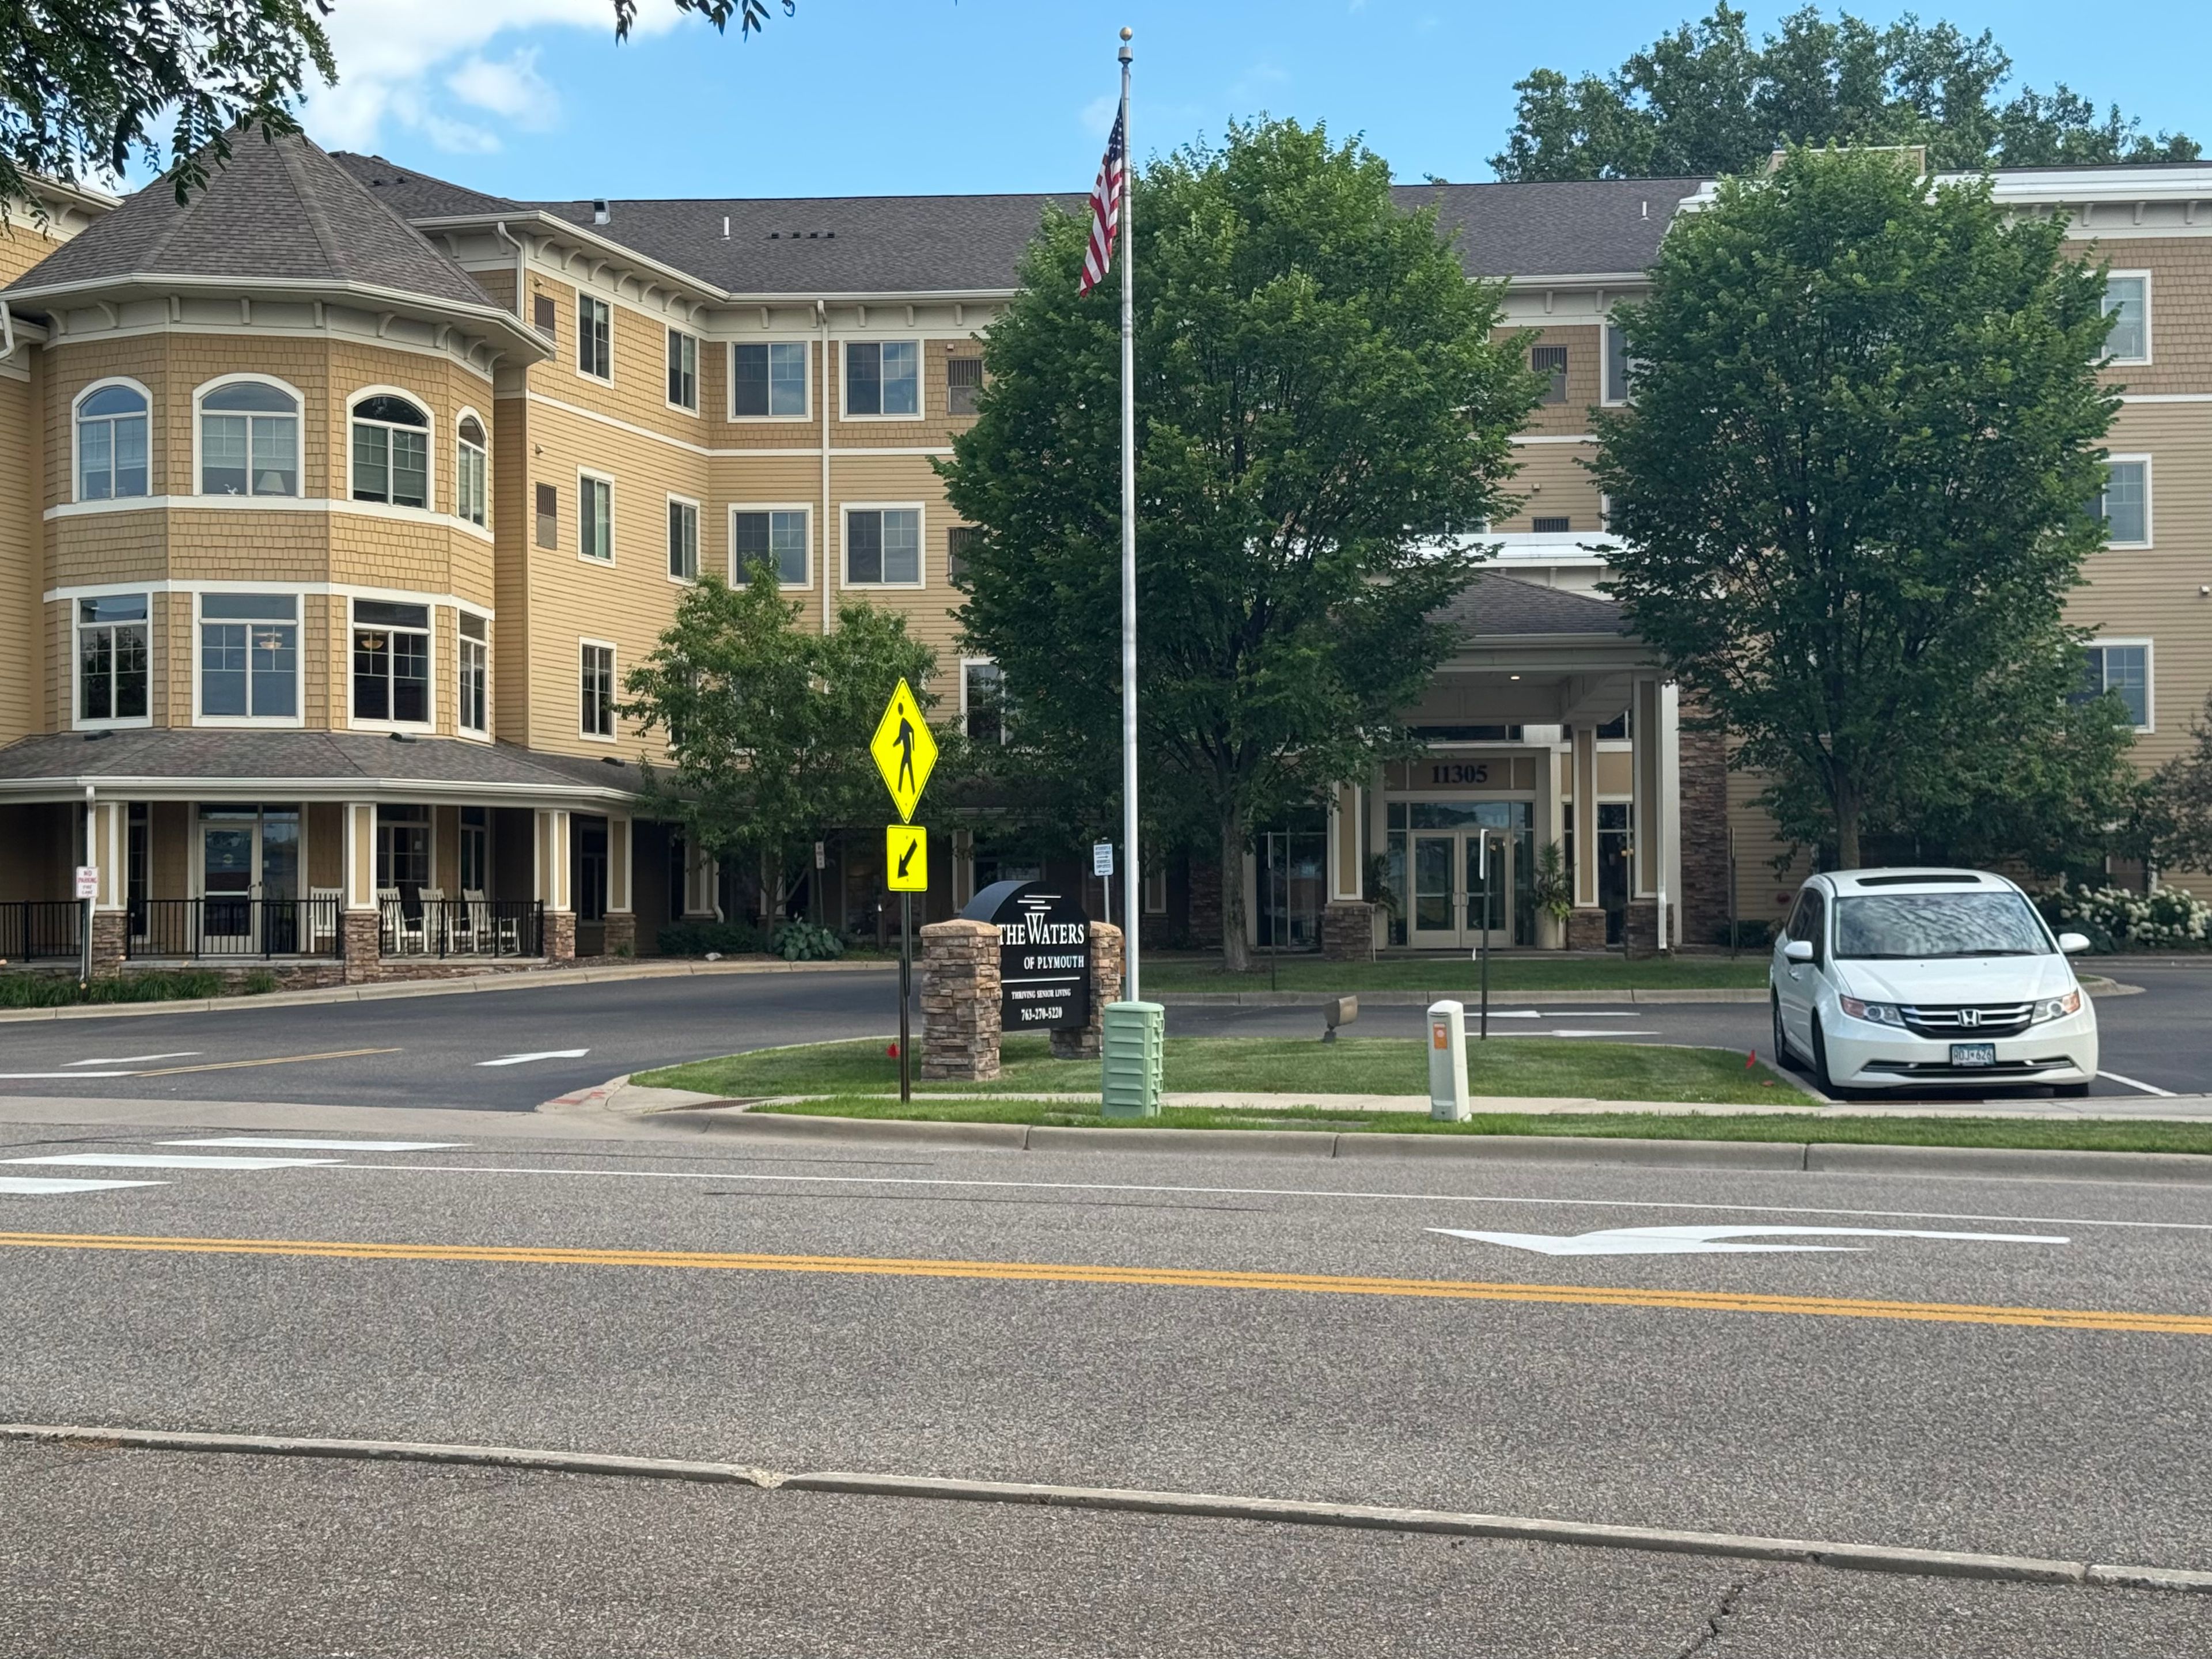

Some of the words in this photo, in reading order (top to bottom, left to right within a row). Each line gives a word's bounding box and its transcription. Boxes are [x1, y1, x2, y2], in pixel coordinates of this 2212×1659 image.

[1432, 764, 1488, 783] 11305
[997, 924, 1026, 945] THE
[1024, 913, 1085, 945] WATERS
[1024, 957, 1035, 969] OF
[1037, 955, 1085, 969] PLYMOUTH
[1012, 991, 1036, 999] THRIVING
[1037, 990, 1054, 998] SENIOR
[1055, 988, 1071, 997] LIVING
[1021, 1007, 1062, 1021] 763-270-5220
[1976, 1050, 1991, 1060] 626
